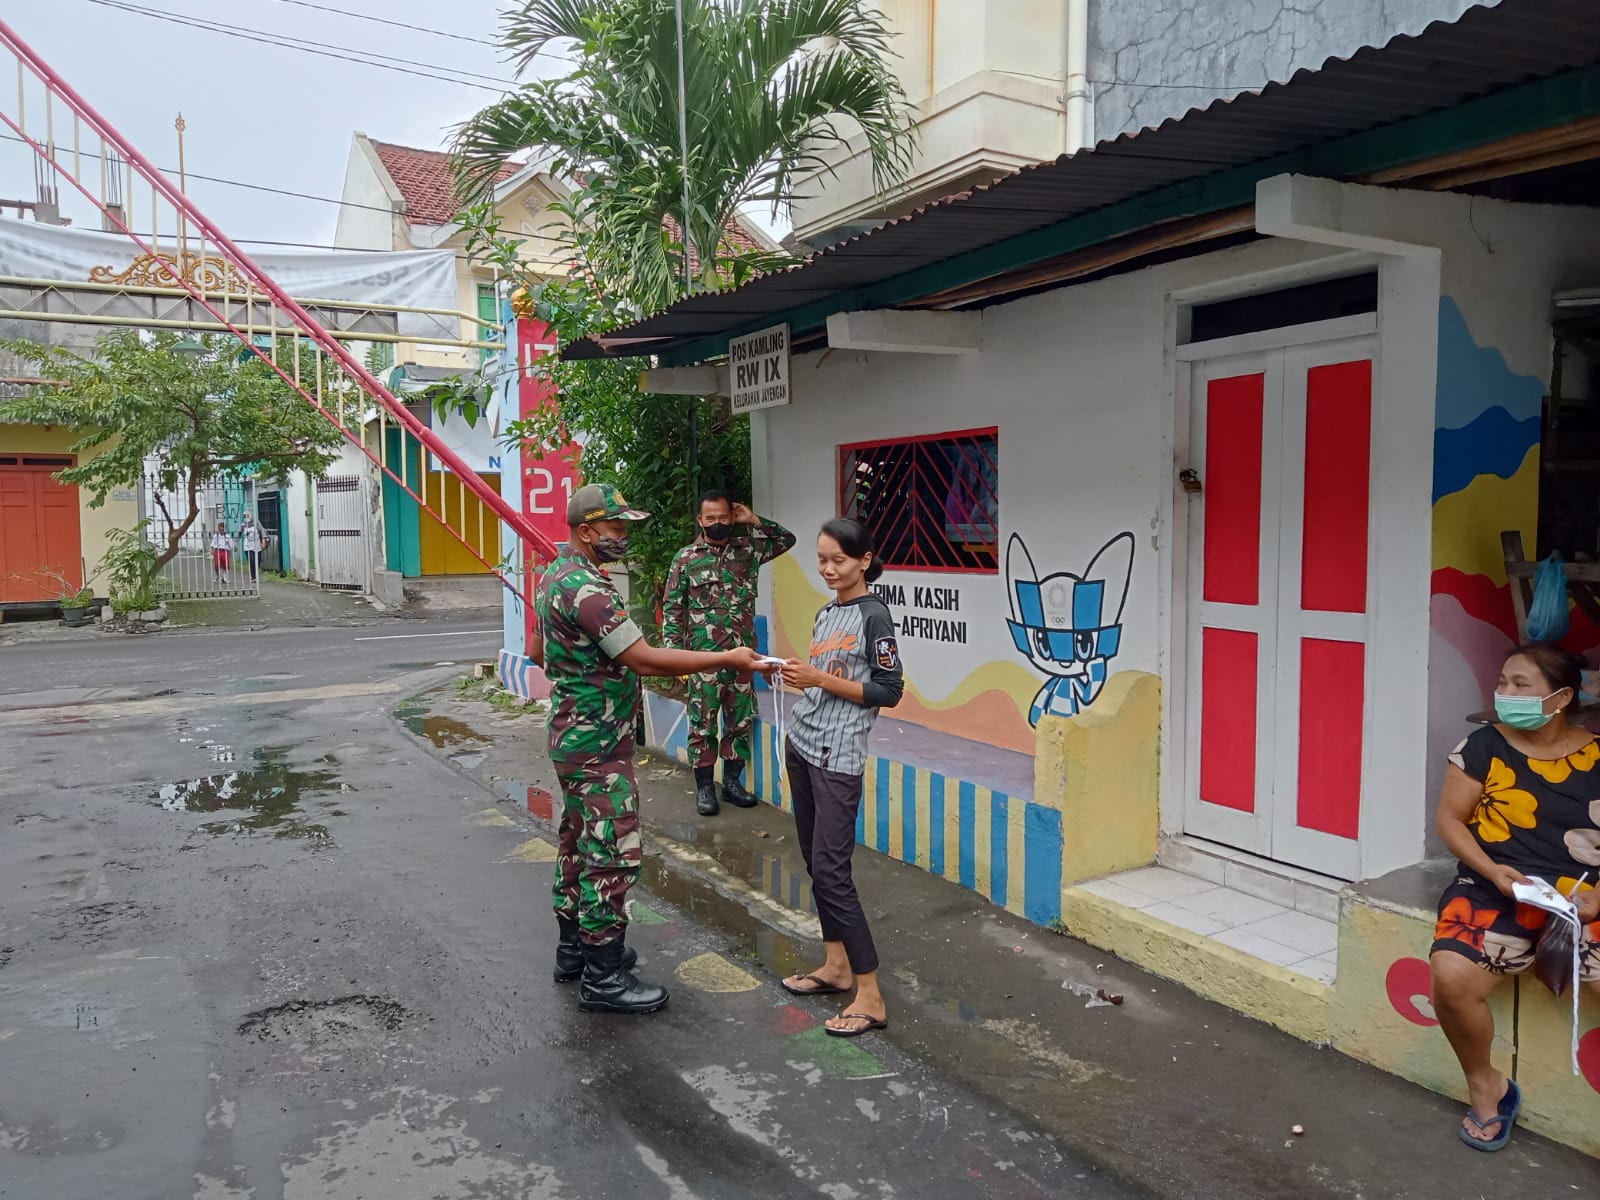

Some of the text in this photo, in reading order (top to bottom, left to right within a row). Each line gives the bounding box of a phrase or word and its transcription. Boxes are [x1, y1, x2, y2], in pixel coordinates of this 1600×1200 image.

[732, 332, 784, 363] POS KAMLING
[737, 355, 781, 389] RW IX
[733, 384, 787, 408] KELURAHAN JAYENGAN
[914, 586, 959, 611] KASIH
